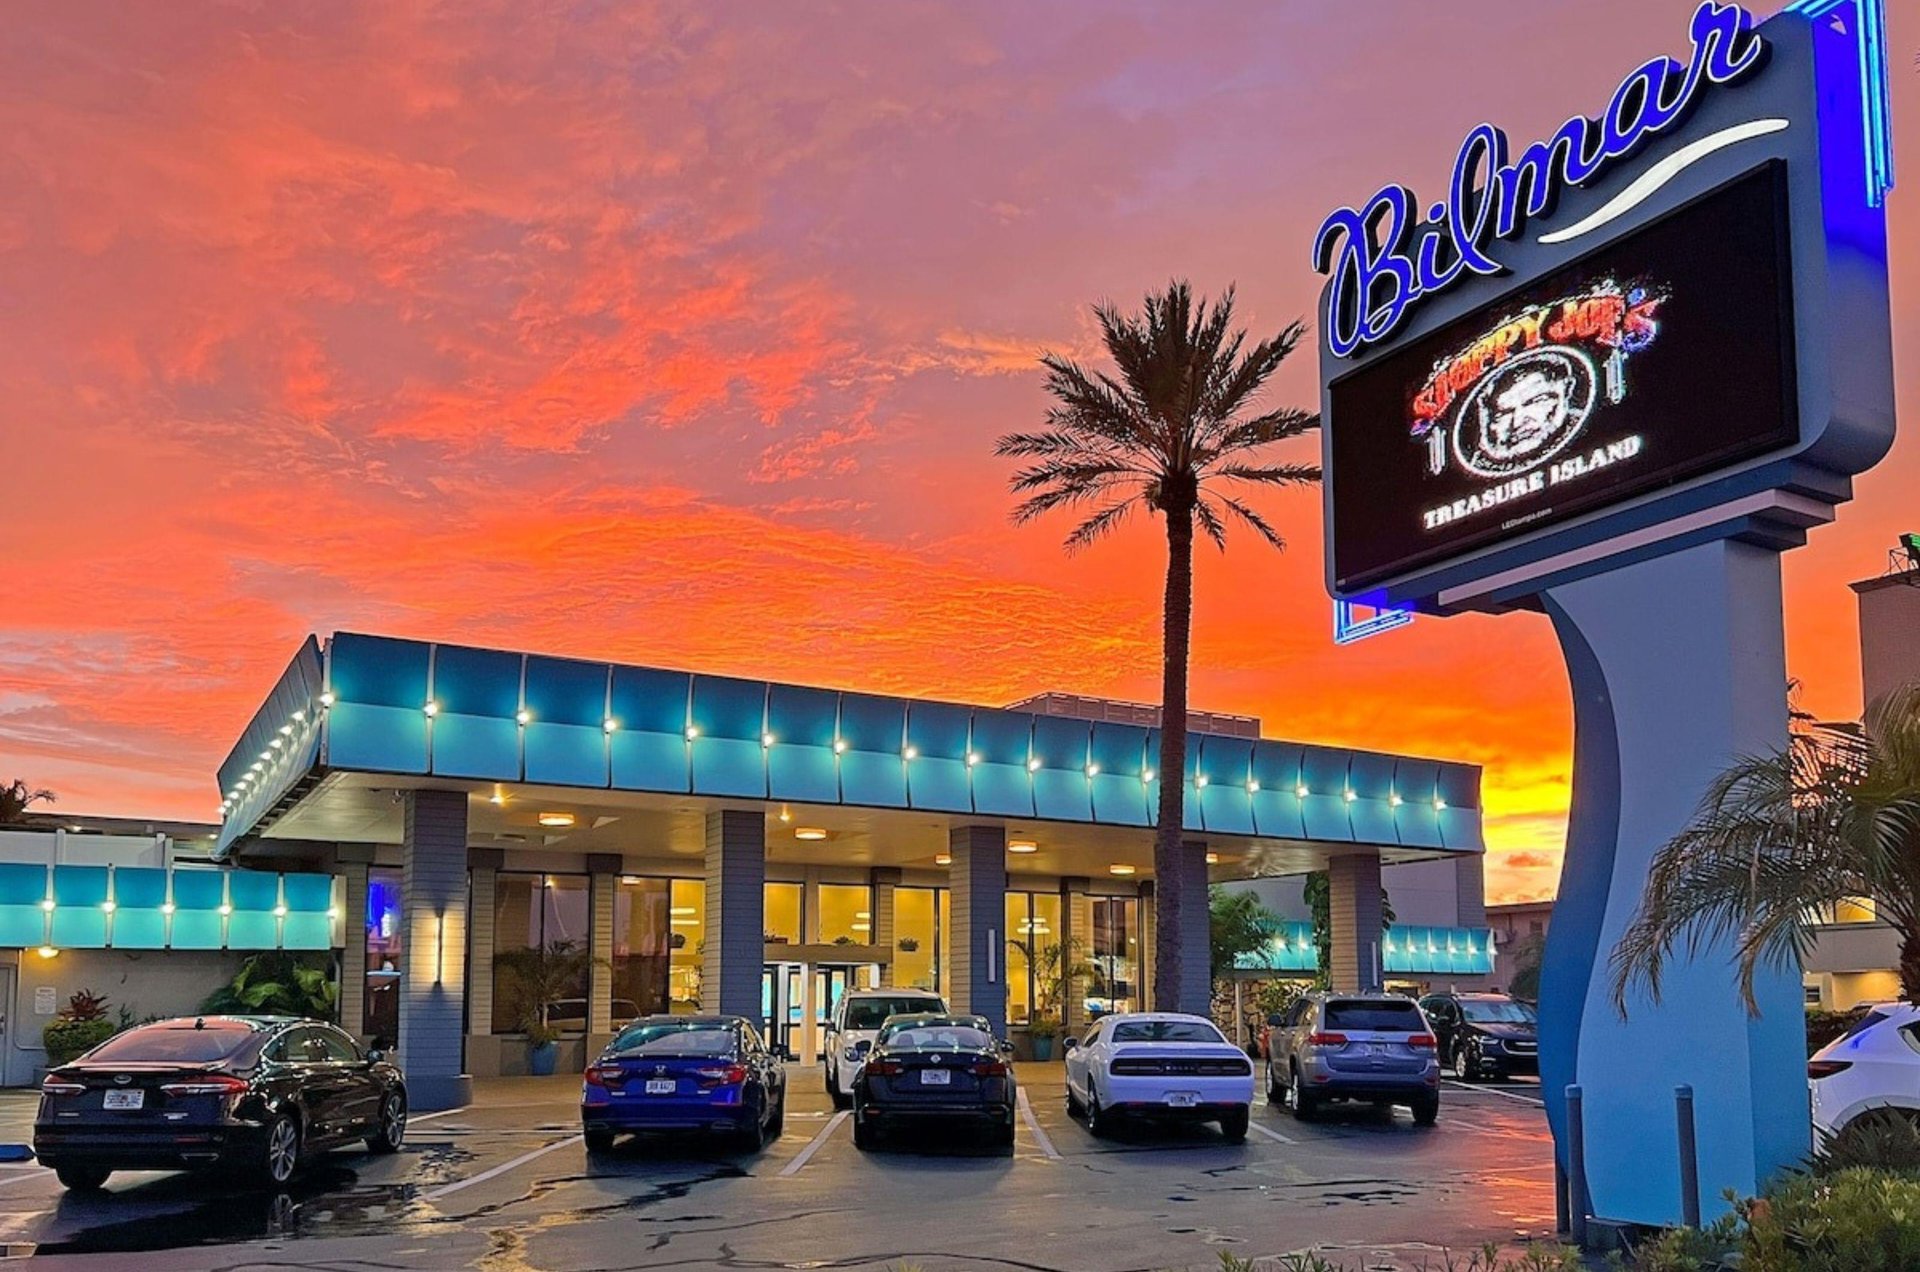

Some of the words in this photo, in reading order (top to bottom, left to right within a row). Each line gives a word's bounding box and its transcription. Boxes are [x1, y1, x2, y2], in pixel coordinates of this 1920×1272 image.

[1312, 0, 1763, 357] Bilmar
[1412, 307, 1551, 420] SLOPPY
[1423, 470, 1545, 530] TREASURE
[1550, 434, 1642, 485] ISLAND
